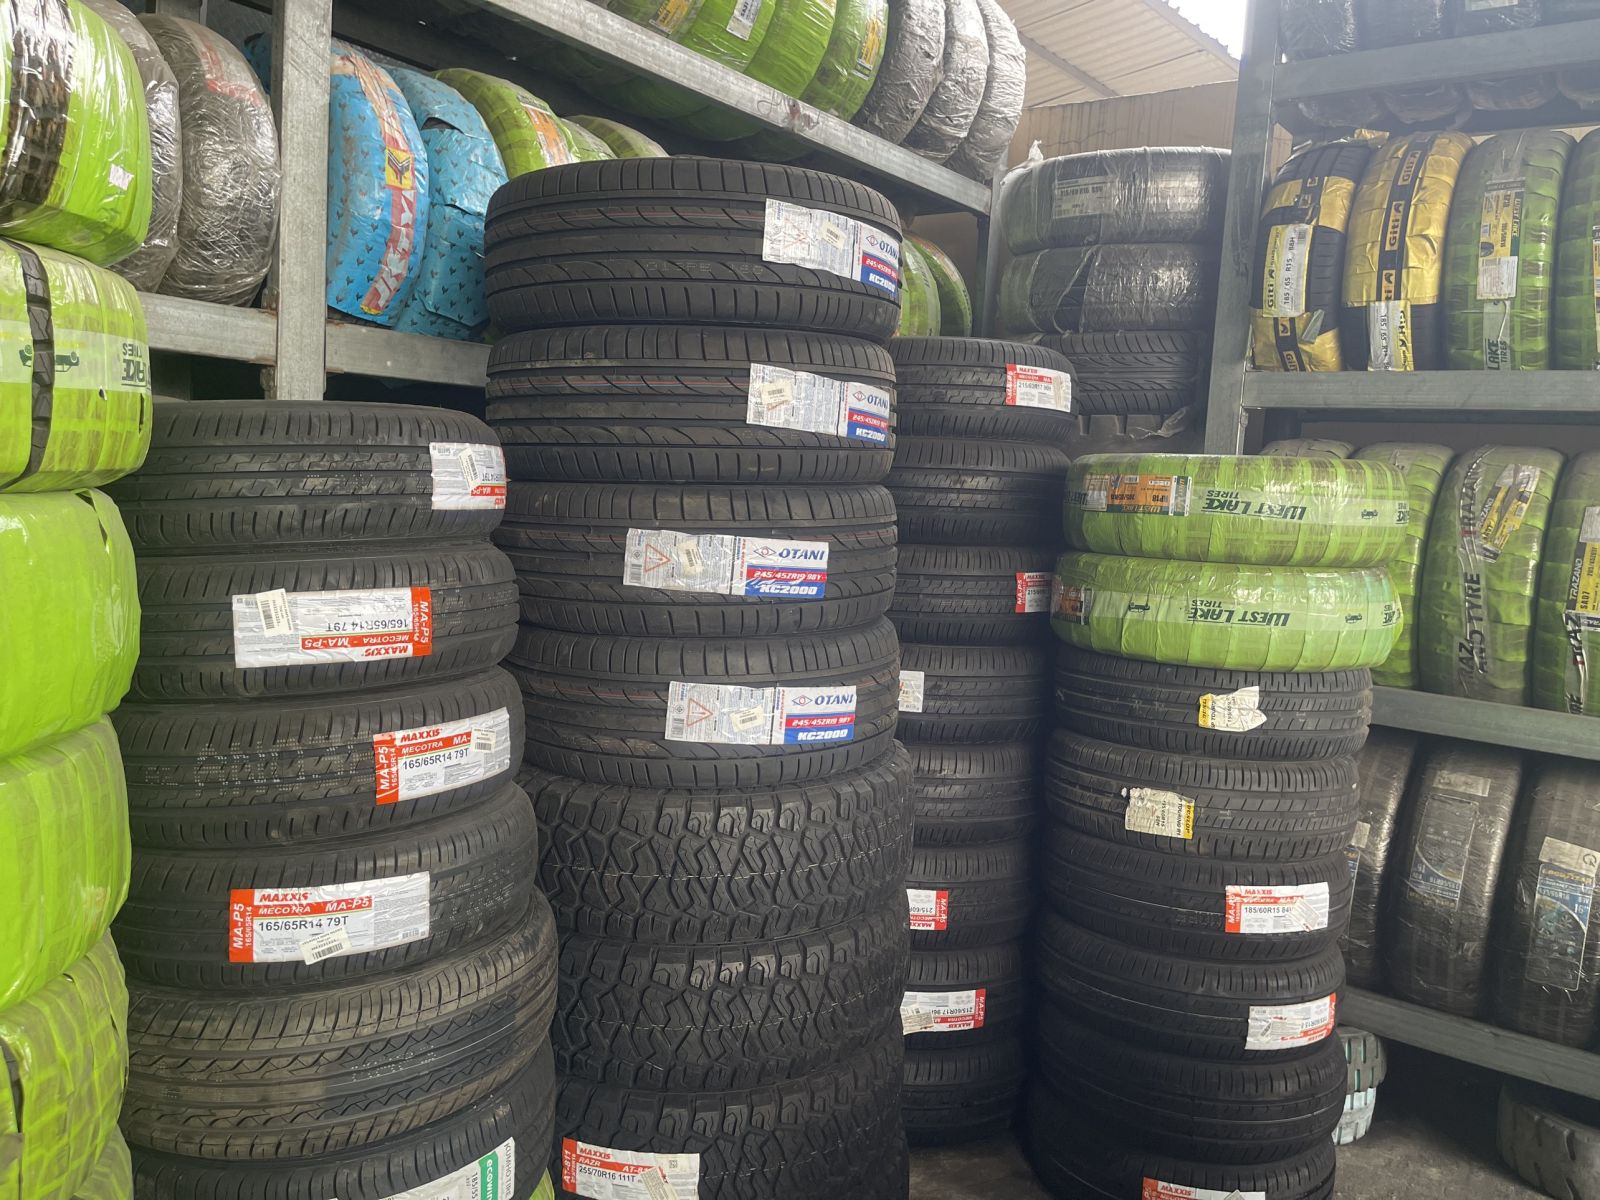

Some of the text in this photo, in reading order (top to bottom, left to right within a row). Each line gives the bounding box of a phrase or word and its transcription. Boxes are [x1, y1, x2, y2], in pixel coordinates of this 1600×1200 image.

[1388, 217, 1400, 248] Giti
[1285, 258, 1293, 272] R15
[1267, 283, 1275, 309] Giti
[1488, 338, 1500, 371] LAKE
[867, 394, 888, 408] OTANI
[855, 428, 886, 441] KC2000
[1207, 490, 1239, 499] TIRES
[1202, 497, 1307, 520] WEST LAKE
[778, 548, 825, 561] OTANI
[753, 569, 806, 580] 245/45ZR19
[1569, 557, 1583, 601] TRAZANO
[760, 584, 818, 595] KC2000
[1191, 599, 1223, 608] TIRES
[1464, 572, 1482, 624] TYRE
[1580, 590, 1590, 609] SA07
[419, 600, 429, 643] MA-P5
[1188, 607, 1290, 626] WEST LAKE
[326, 618, 409, 632] 165/65R14 79T
[304, 634, 409, 648] MECOTRA MA-P5
[364, 644, 409, 656] MAXXIS
[814, 694, 854, 706] OTANI
[791, 717, 838, 727] 245/45ZR19
[400, 728, 441, 743] MAXXIS
[797, 729, 849, 741] KC2000
[401, 741, 444, 754] MECOTRA
[403, 748, 470, 770] 165/65R14 79T
[379, 746, 390, 790] MA-P5
[259, 892, 310, 903] MAXXIS
[258, 897, 370, 915] MECOTRA MA-P5
[1244, 906, 1280, 914] 185/60R15
[233, 903, 244, 949] MA-P5
[258, 916, 349, 932] 165/65R14 79T
[504, 1142, 512, 1178] KUMHO
[580, 1147, 611, 1160] MAXXIS
[578, 1156, 601, 1167] RAZR
[579, 1165, 636, 1183] 255/70R16 111T
[1161, 1185, 1193, 1196] MAXXIS
